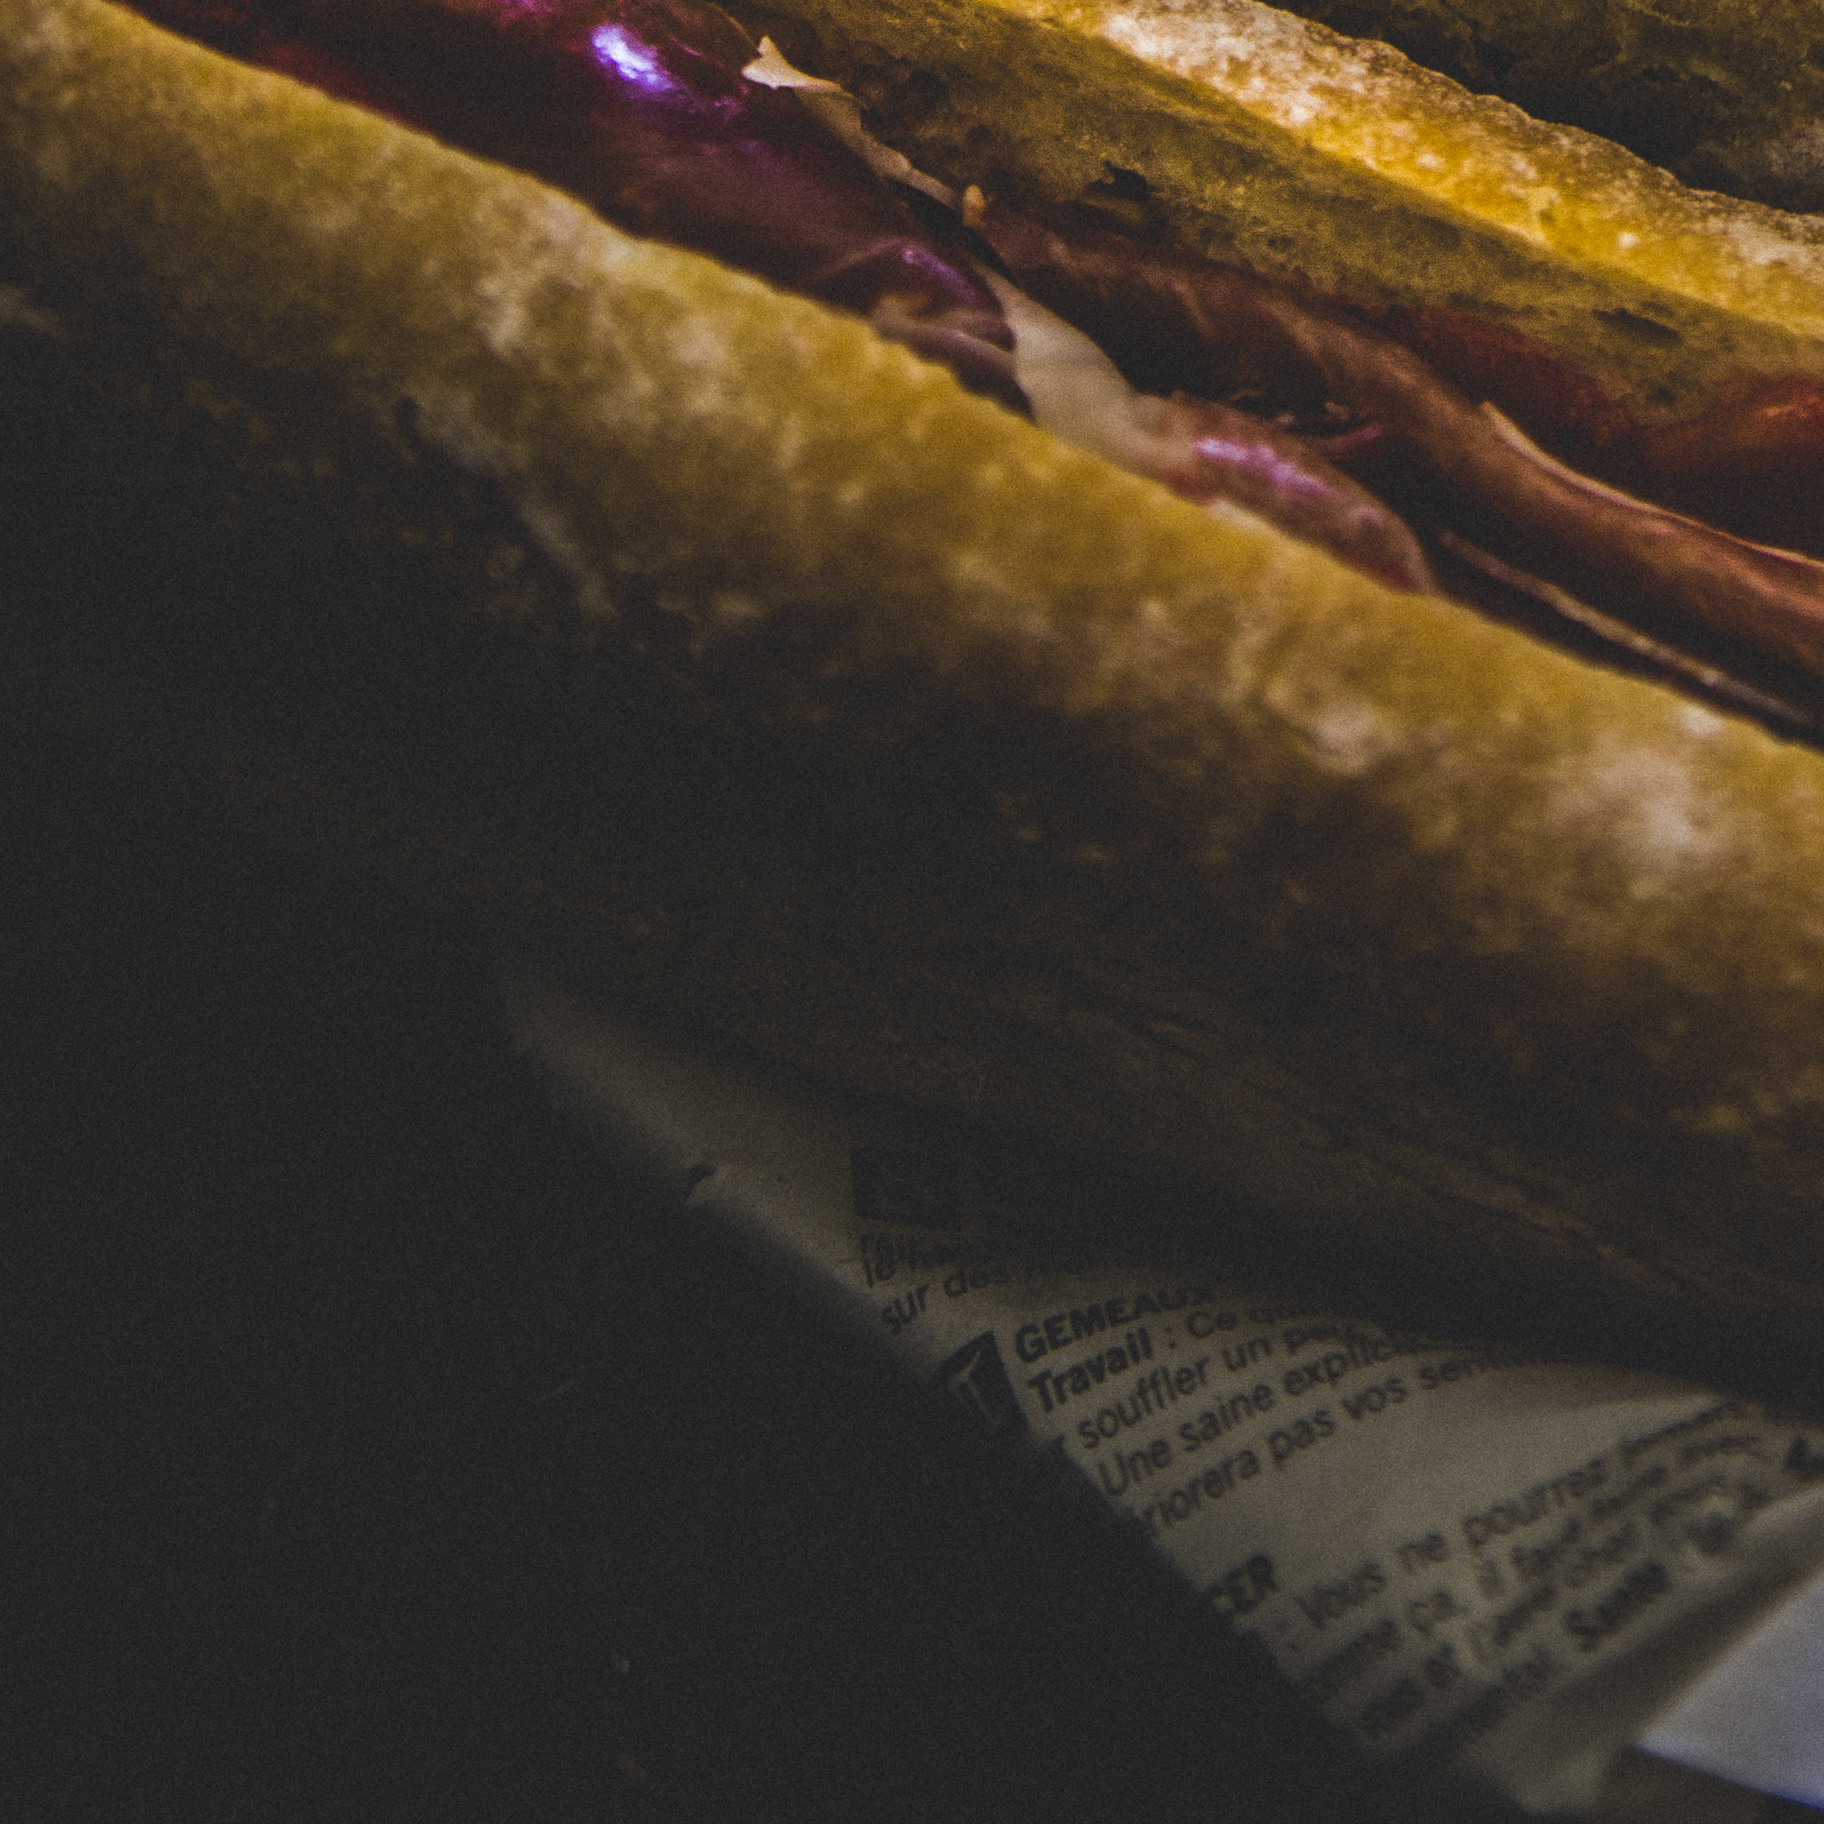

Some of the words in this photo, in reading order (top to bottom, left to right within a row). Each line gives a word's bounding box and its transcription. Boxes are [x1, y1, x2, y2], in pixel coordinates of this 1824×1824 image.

[882, 1284, 930, 1335] sur
[1014, 1285, 1215, 1364] GEMEAUX
[1028, 1327, 1153, 1412] Travail
[1186, 1308, 1240, 1339] Ce
[1078, 1354, 1211, 1452] souffler
[1222, 1335, 1274, 1373] un
[1097, 1437, 1174, 1498] Une
[1178, 1380, 1276, 1453] saine
[1267, 1406, 1336, 1469] pas
[1341, 1374, 1408, 1423] vos
[1295, 1561, 1388, 1632] Vous
[1397, 1531, 1450, 1575] ne
